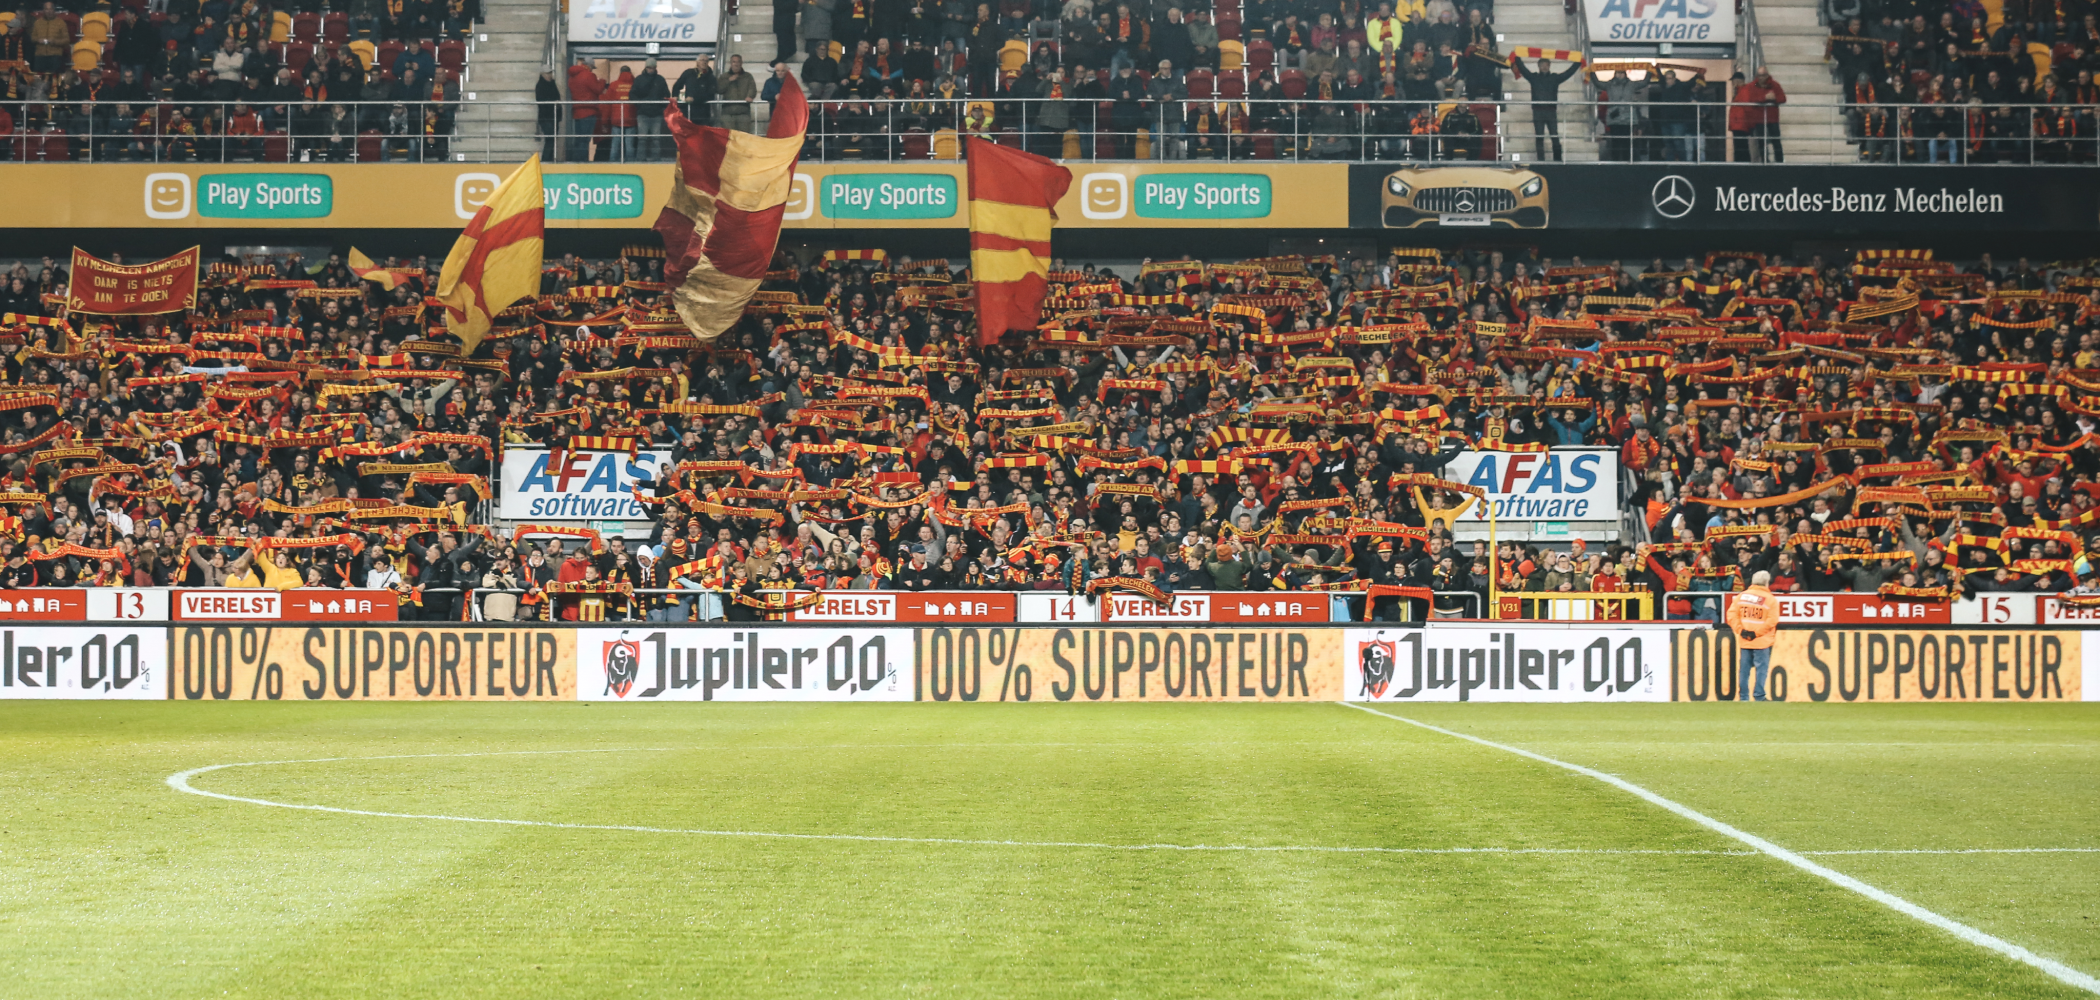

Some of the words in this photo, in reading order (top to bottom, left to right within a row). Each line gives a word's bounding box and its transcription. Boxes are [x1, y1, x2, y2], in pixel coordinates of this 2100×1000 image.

[594, 19, 695, 39] software
[1610, 19, 1710, 39] software
[208, 183, 250, 210] Play
[256, 183, 322, 210] Sports
[567, 183, 632, 210] Sports
[831, 183, 874, 210] Play
[880, 183, 946, 210] Sports
[1145, 182, 1188, 210] Play
[1194, 182, 1260, 210] Sports
[1715, 186, 1887, 213] Mercedes-Benz
[1893, 187, 2004, 213] Mechelen
[77, 256, 88, 267] KV
[94, 276, 118, 289] DAAR
[1079, 284, 1113, 294] KVM
[71, 295, 86, 309] KV
[94, 292, 113, 304] AAN
[124, 294, 136, 303] TE
[142, 290, 169, 303] DOEN
[785, 322, 823, 331] KVM
[203, 331, 245, 341] KVM
[1134, 336, 1171, 345] MECHELEN
[1287, 330, 1325, 341] MECHELEN
[1354, 332, 1406, 343] MECHELEN
[138, 343, 171, 352] KVM
[401, 343, 412, 351] KV
[413, 343, 456, 353] MECHELEN
[652, 337, 707, 348] MALINWA
[1022, 369, 1058, 377] MECHELEN
[149, 374, 190, 384] KVM
[1115, 380, 1157, 389] KVM
[845, 388, 918, 397] STRAATSBURG
[177, 424, 205, 438] KVM
[1031, 424, 1071, 434] MECHELEN
[420, 436, 432, 445] KV
[433, 436, 482, 446] MECHELEN
[359, 446, 397, 455] KVM
[803, 443, 845, 454] KVM
[1242, 445, 1262, 454] K.V.
[1265, 441, 1313, 453] MECHELEN
[40, 450, 52, 460] KV
[54, 447, 98, 459] MECHELEN
[1098, 450, 1108, 458] De
[69, 467, 86, 475] K.V.
[88, 464, 134, 475] MECHELEN
[697, 460, 741, 468] MECHELEN
[518, 454, 656, 492] AFAS
[749, 468, 793, 477] MECHELEN
[1469, 454, 1601, 494] AFAS
[1414, 474, 1439, 486] KVM
[753, 491, 788, 499] MECHEL
[1932, 491, 1944, 500] KV
[1946, 490, 1990, 500] MECHELEN
[530, 492, 642, 517] software
[1291, 498, 1340, 509] MECHELEN
[1475, 494, 1588, 518] software
[370, 505, 425, 516] MECHELEN
[430, 523, 469, 533] MECHELEN
[536, 524, 580, 535] KVM
[1356, 525, 1397, 535] MECHELEN
[1399, 527, 1405, 535] 4
[1408, 528, 1427, 539] EVER
[1711, 527, 1725, 535] KV
[2017, 528, 2061, 539] KVM
[271, 536, 286, 546] KV
[287, 535, 340, 546] MECHELEN
[1289, 535, 1344, 545] MECHELEN
[1697, 566, 1736, 576] MECHELEN
[2020, 560, 2069, 571] KVM
[579, 583, 615, 592] MECHELEN
[1120, 579, 1156, 595] MECHELEN
[187, 597, 276, 614] VERELST
[804, 600, 890, 616] VERELST
[1050, 599, 1075, 620] 14
[1115, 600, 1205, 617] VERELST
[1502, 604, 1519, 613] V31
[1780, 602, 1828, 617] ELST
[1981, 597, 2010, 623] 15
[1740, 606, 1765, 620] TEWARD
[4, 630, 73, 688] ler
[167, 627, 283, 700] 100%
[302, 627, 559, 700] SUPPORTEUR
[914, 627, 1032, 701] 100%
[1051, 628, 1310, 701] SUPPORTEUR
[637, 631, 818, 701] Jupiler
[1394, 632, 1575, 702] Jupiler
[1807, 629, 2064, 701] SUPPORTEUR
